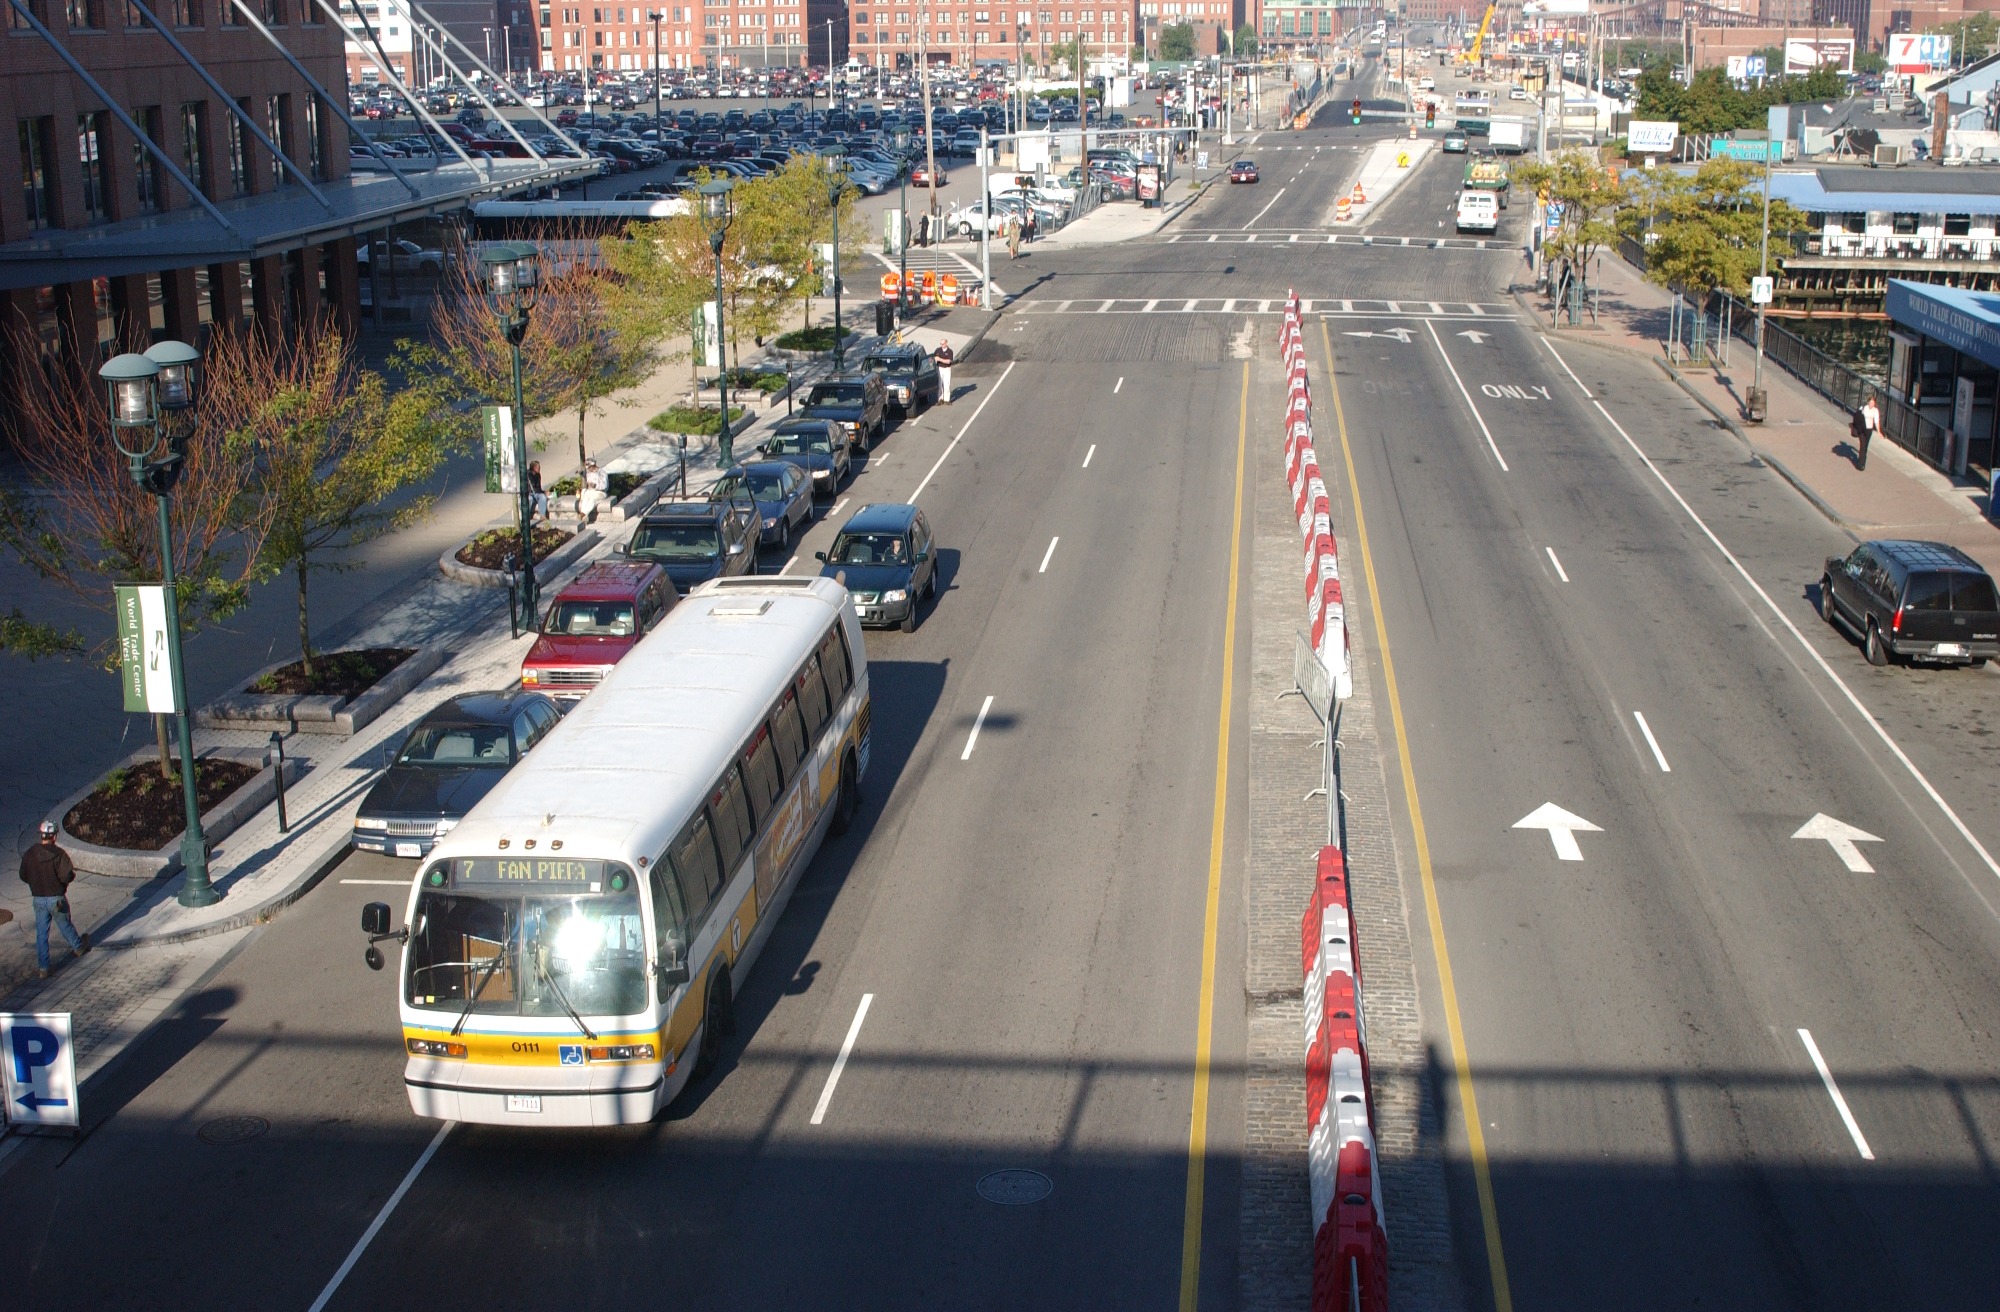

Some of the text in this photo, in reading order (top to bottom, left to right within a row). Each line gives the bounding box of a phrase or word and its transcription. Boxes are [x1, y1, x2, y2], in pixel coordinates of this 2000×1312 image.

[1899, 38, 1915, 56] 7
[1734, 59, 1741, 72] 7
[1908, 294, 1929, 315] WORLD
[1929, 303, 1949, 325] TRADE
[1949, 311, 1975, 336] CENTER
[1481, 384, 1552, 400] ONLY
[122, 637, 130, 662] West
[126, 597, 142, 698] World Trade Center
[463, 860, 474, 879] 7
[498, 861, 532, 880] FAN
[11, 1026, 59, 1084] P
